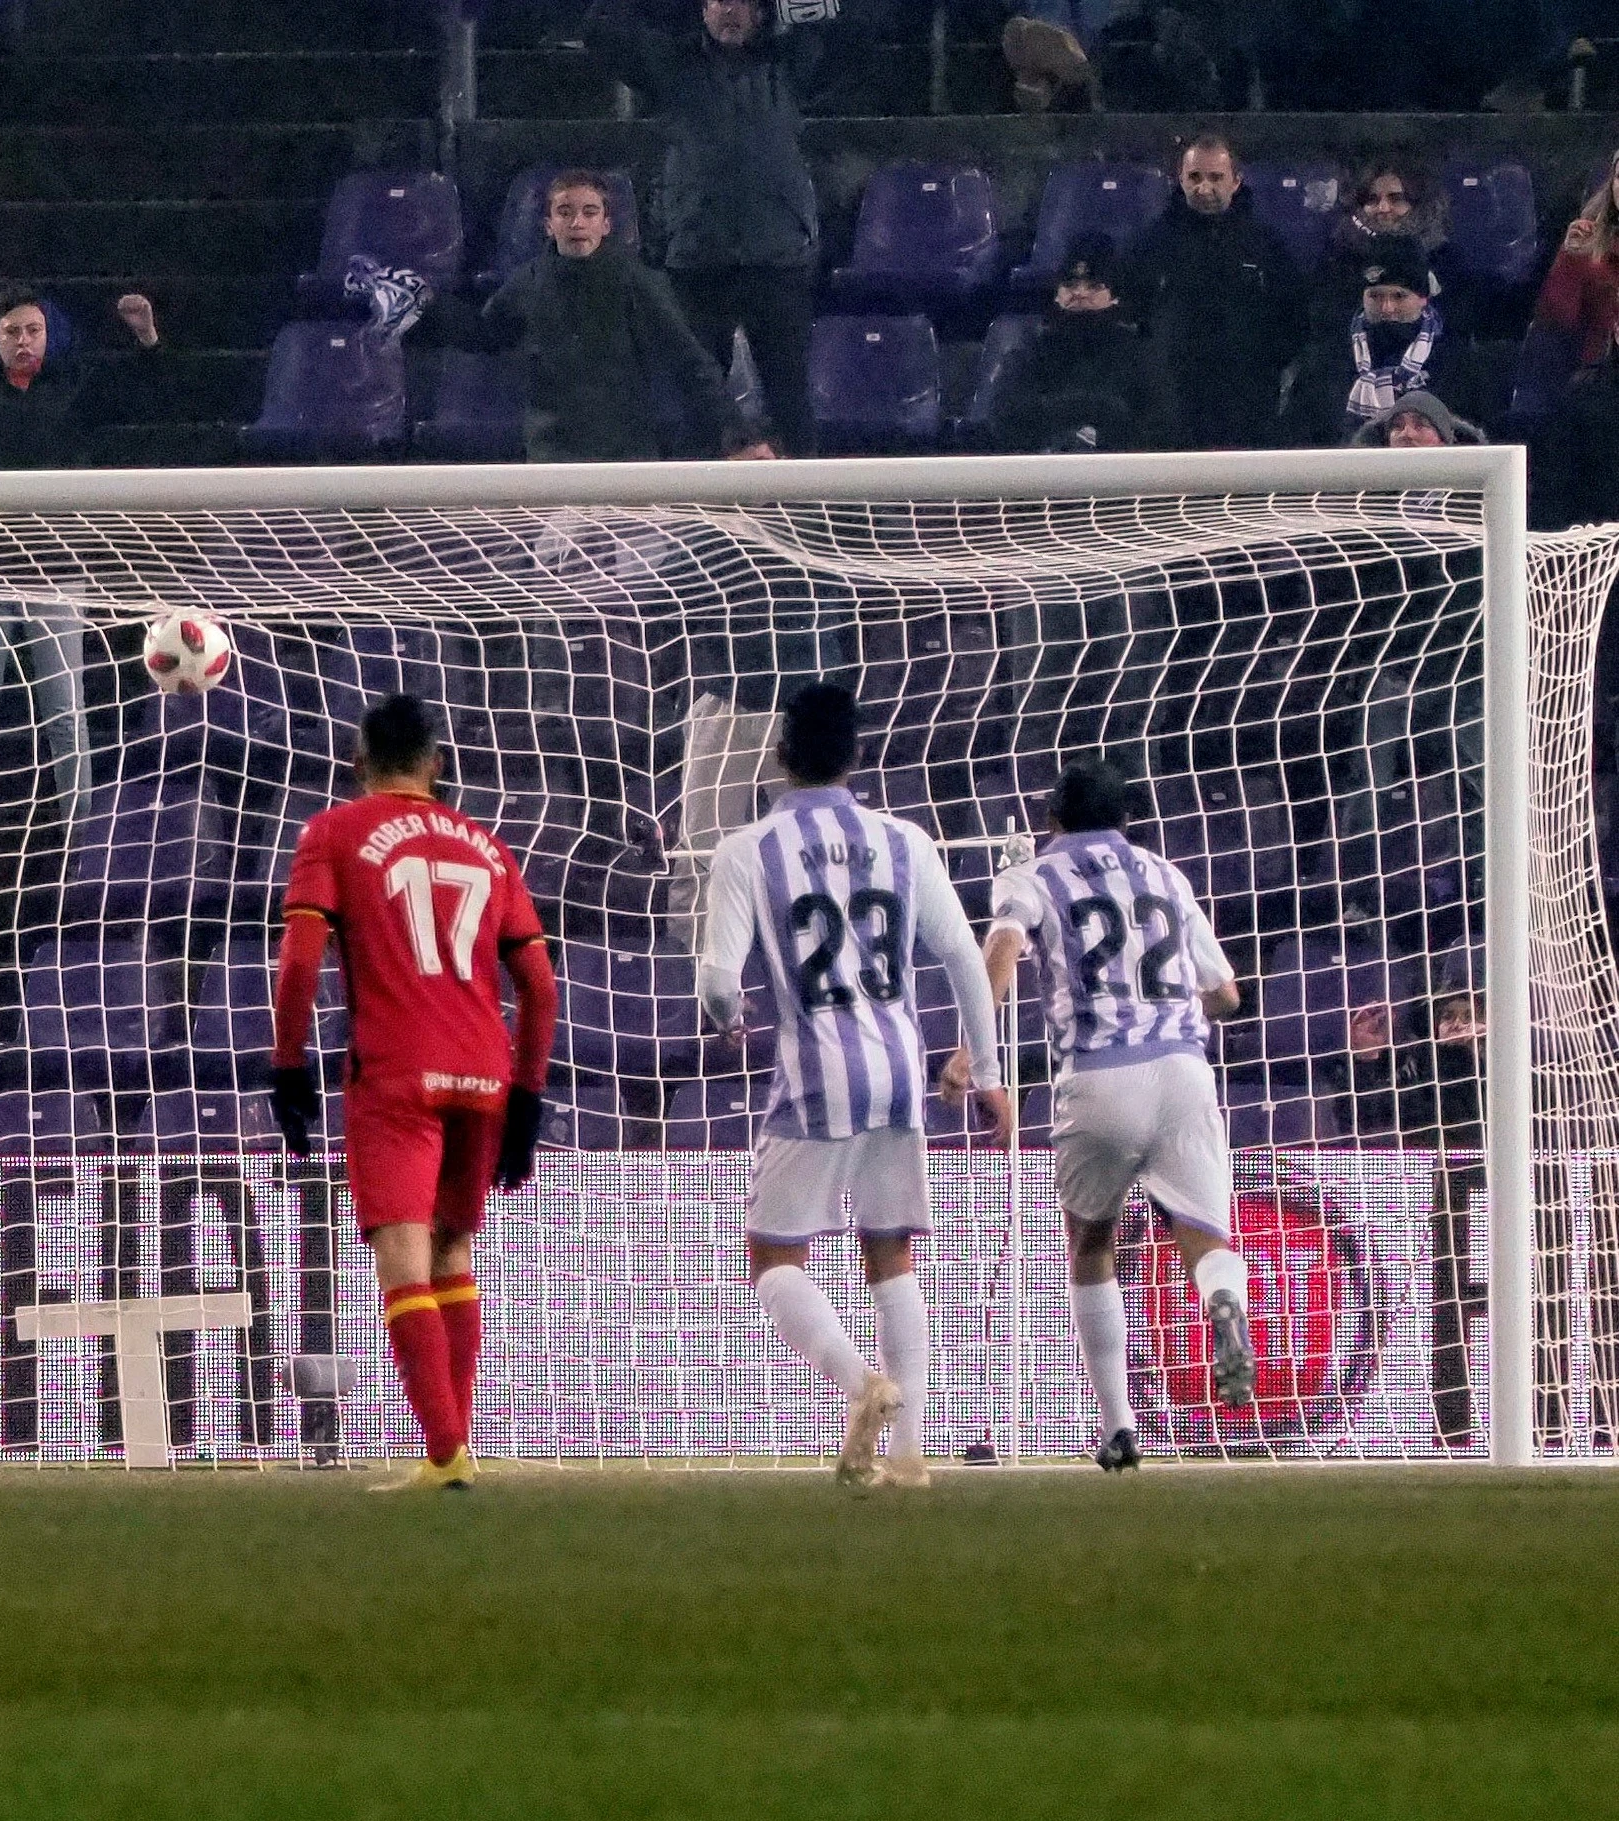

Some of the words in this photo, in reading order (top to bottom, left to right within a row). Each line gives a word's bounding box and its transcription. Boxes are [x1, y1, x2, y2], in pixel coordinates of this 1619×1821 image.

[359, 813, 427, 866] ROBER
[385, 856, 492, 982] 17
[788, 887, 907, 1013] 23
[1069, 891, 1192, 1005] 22
